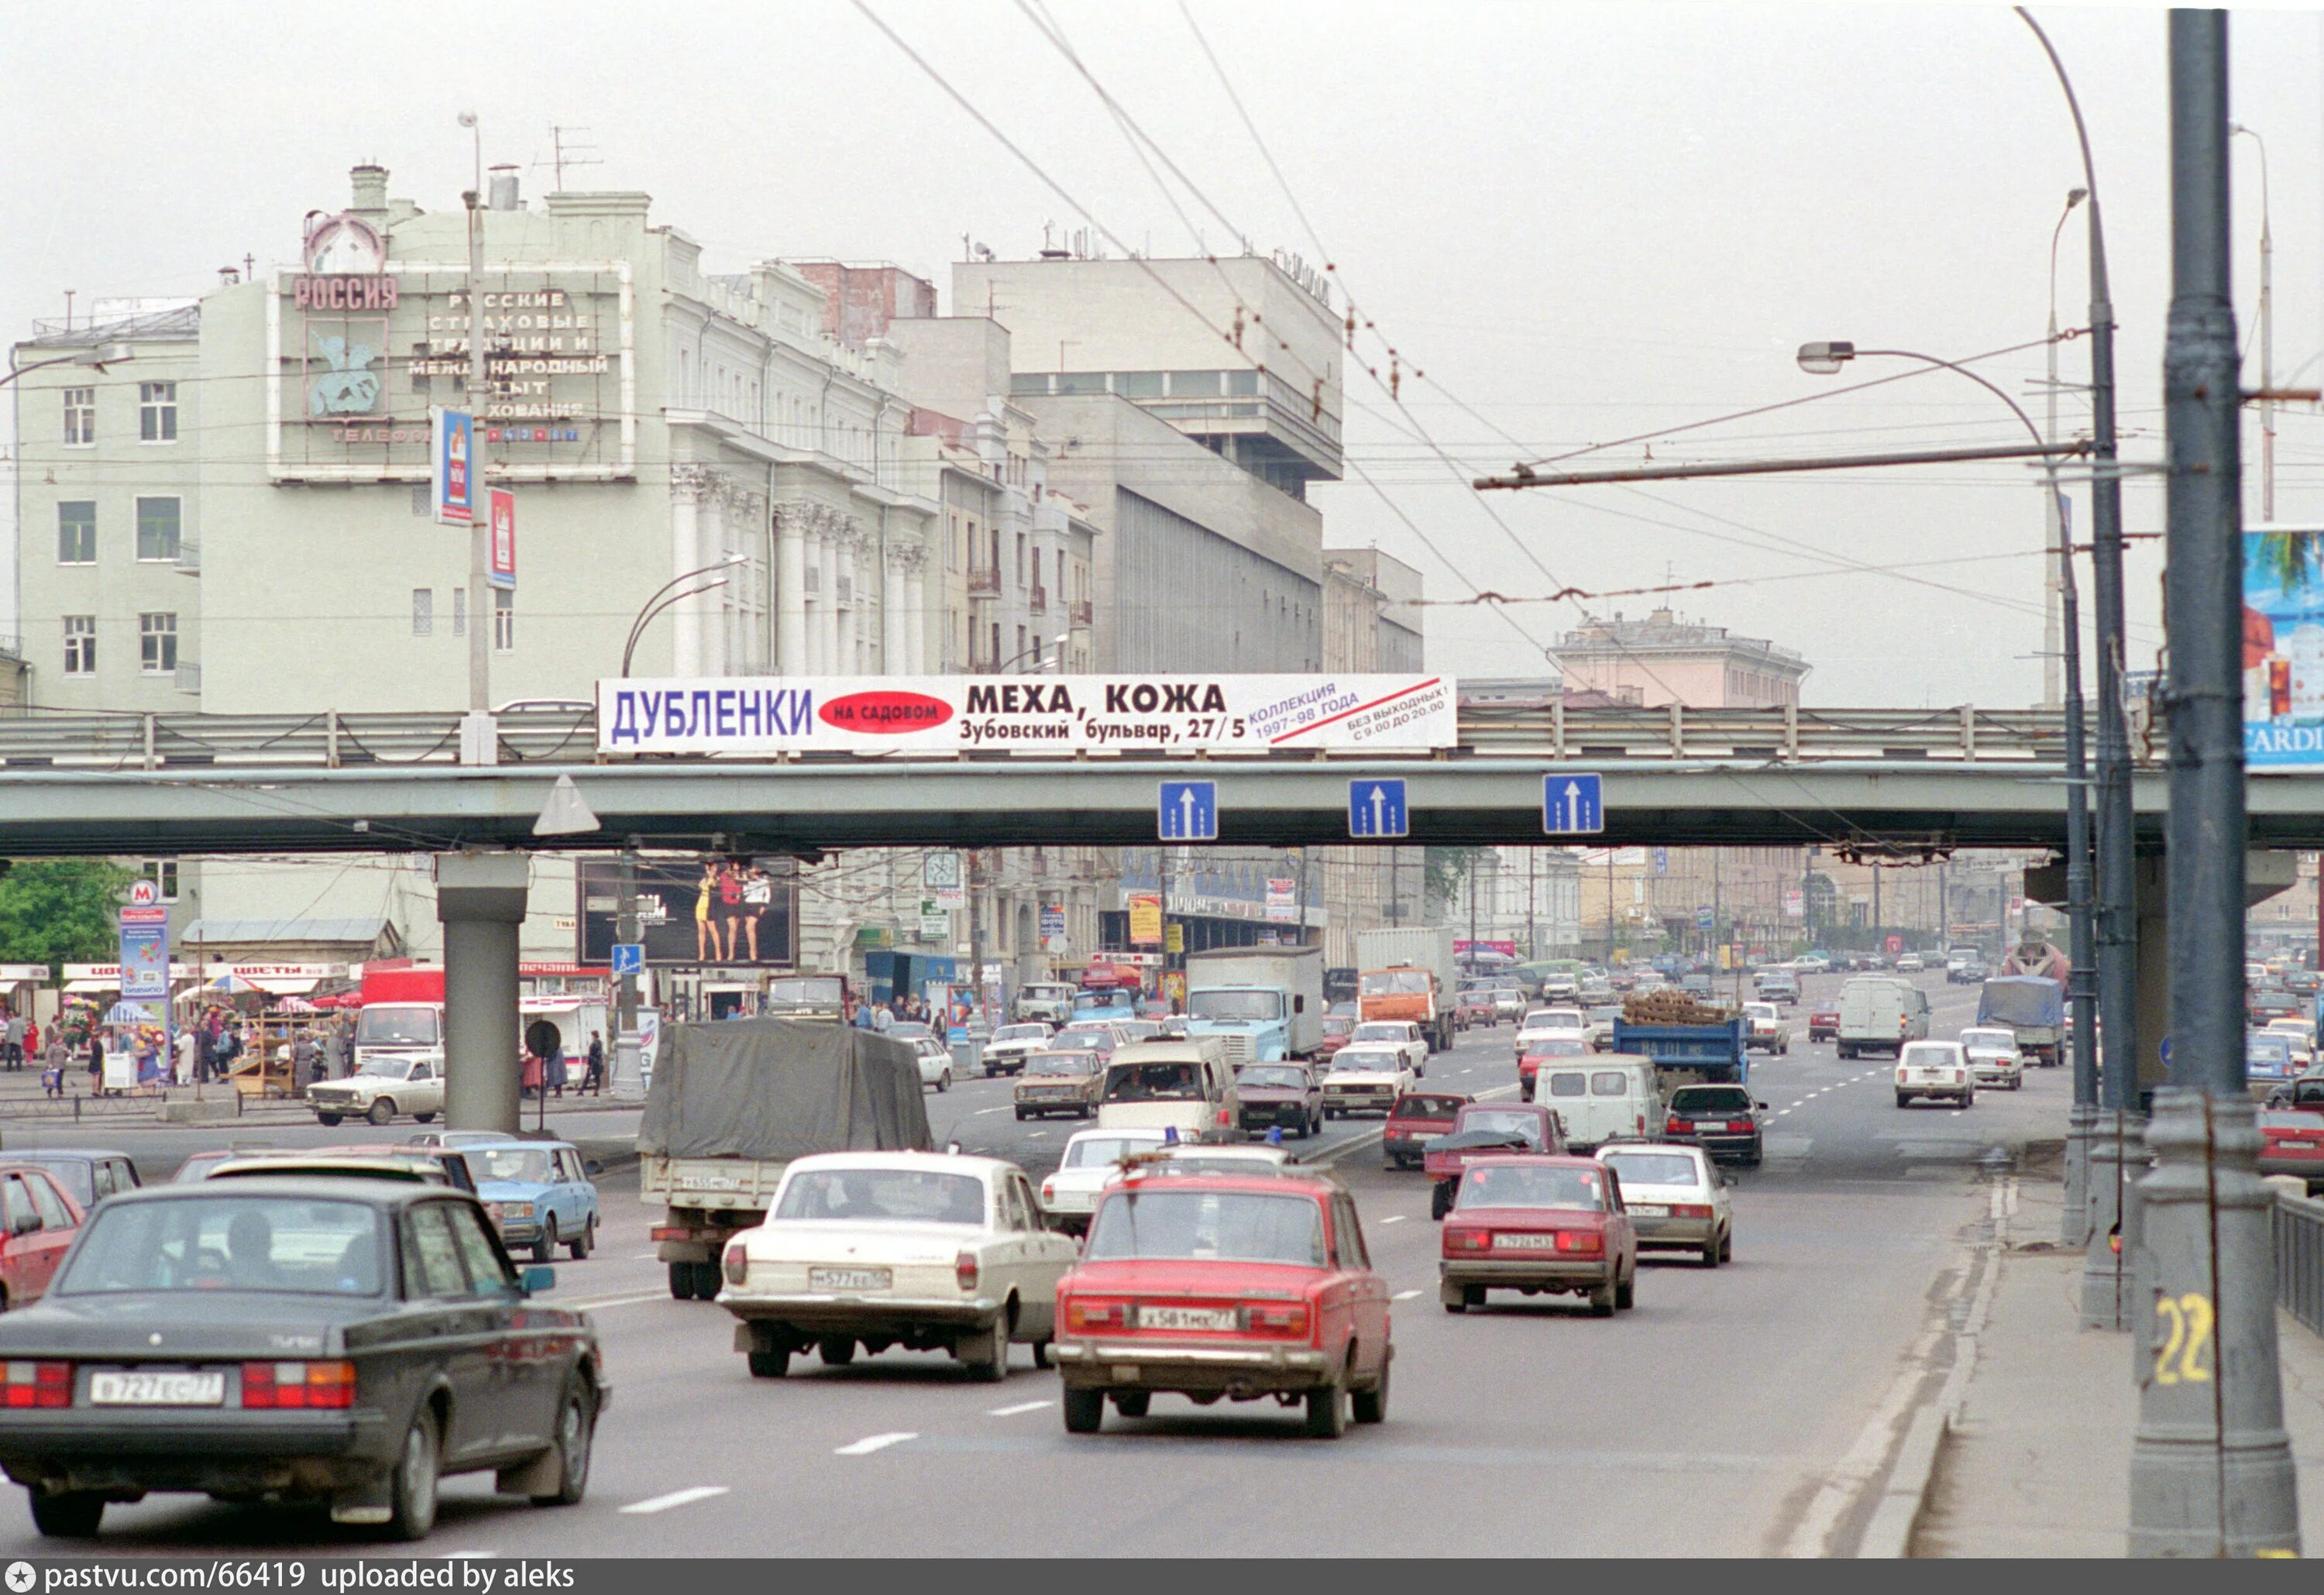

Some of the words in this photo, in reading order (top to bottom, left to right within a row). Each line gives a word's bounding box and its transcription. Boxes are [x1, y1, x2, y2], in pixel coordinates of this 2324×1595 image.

[295, 277, 397, 310] РОССИЯ
[575, 337, 589, 350] И
[611, 689, 813, 744] ДУБЛЕНКИ
[834, 706, 854, 720] НА
[861, 705, 940, 720] САДОВОМ
[966, 685, 1087, 721] МЕХА,
[1106, 684, 1226, 713] КОЖА
[1249, 682, 1336, 726] КОЛЛЕКЦИЯ
[1255, 707, 1315, 740] 1997-98
[1321, 692, 1360, 715] ГОДА
[1364, 721, 1391, 737] 9.00
[1393, 713, 1411, 729] ДО
[1411, 700, 1446, 720] 20.00
[960, 718, 1070, 744] Зубовский
[1085, 717, 1181, 744] бульвар,
[1187, 716, 1246, 740] 27/5
[1347, 715, 1372, 731] БЕЗ
[134, 886, 151, 901] М
[233, 967, 302, 975] ЦВЕТЫ
[2155, 1292, 2213, 1385] 22
